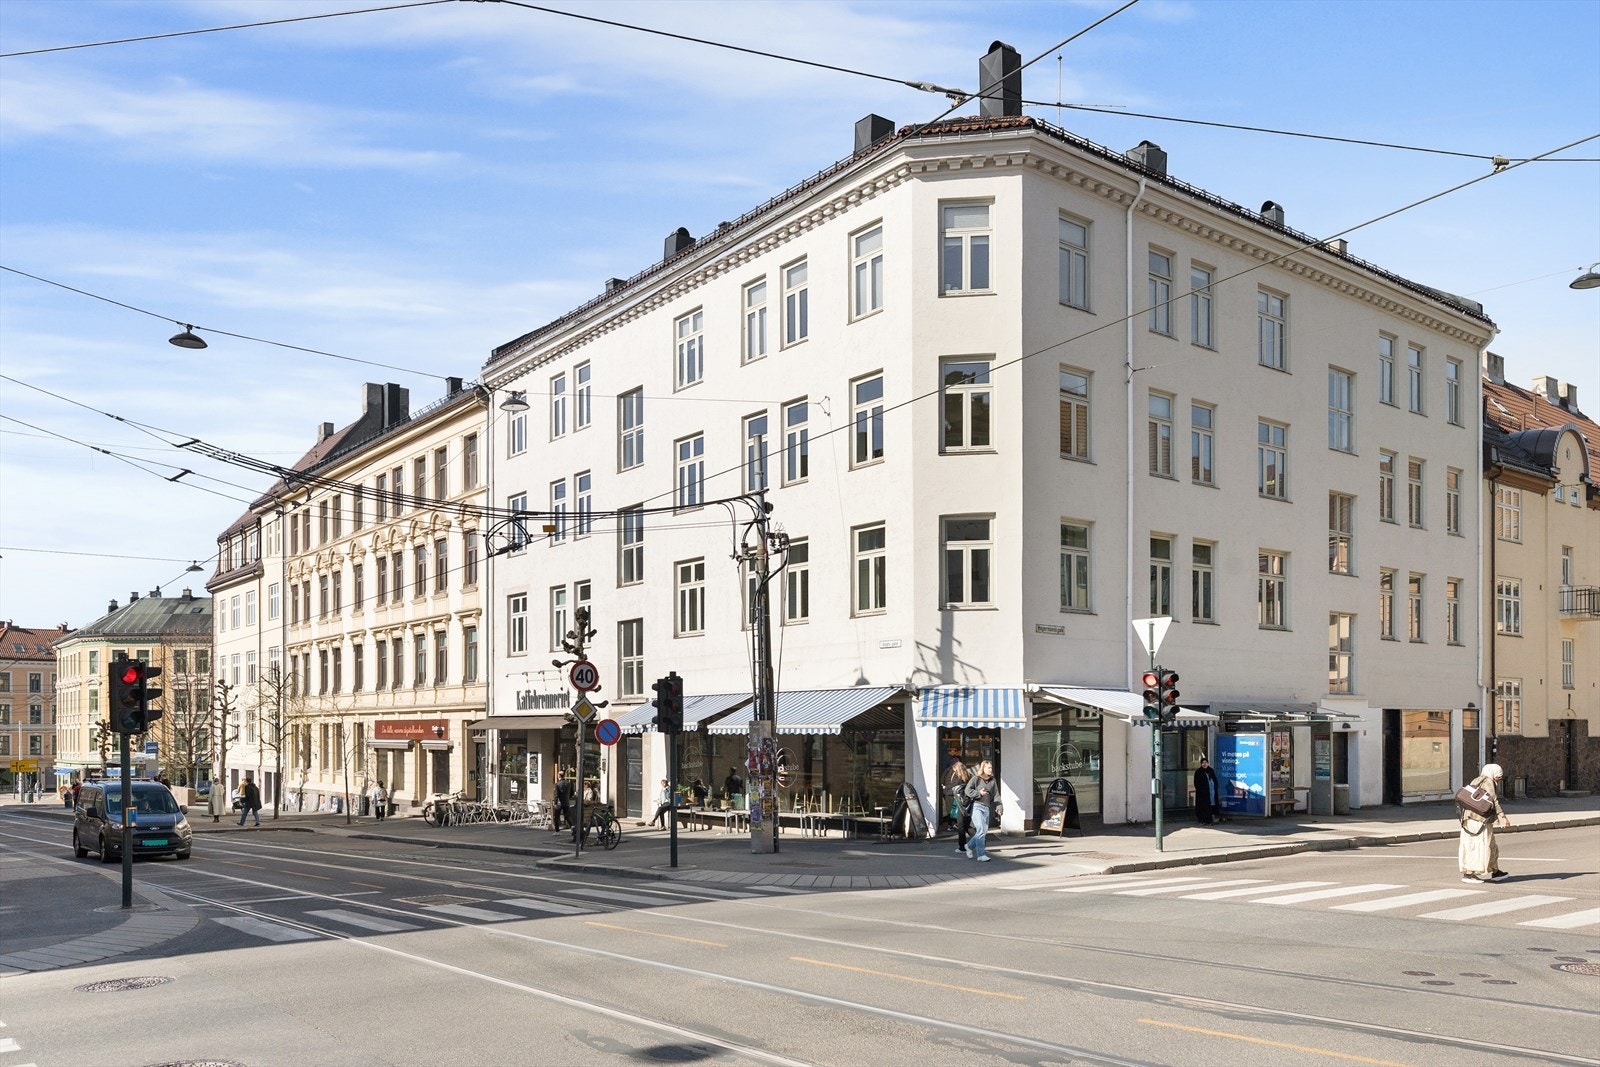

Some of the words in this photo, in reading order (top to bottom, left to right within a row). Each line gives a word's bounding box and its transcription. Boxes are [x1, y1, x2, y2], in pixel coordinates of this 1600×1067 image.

[575, 669, 594, 683] 40
[516, 689, 570, 710] Kaffebrenneriet
[1051, 760, 1083, 773] backstube
